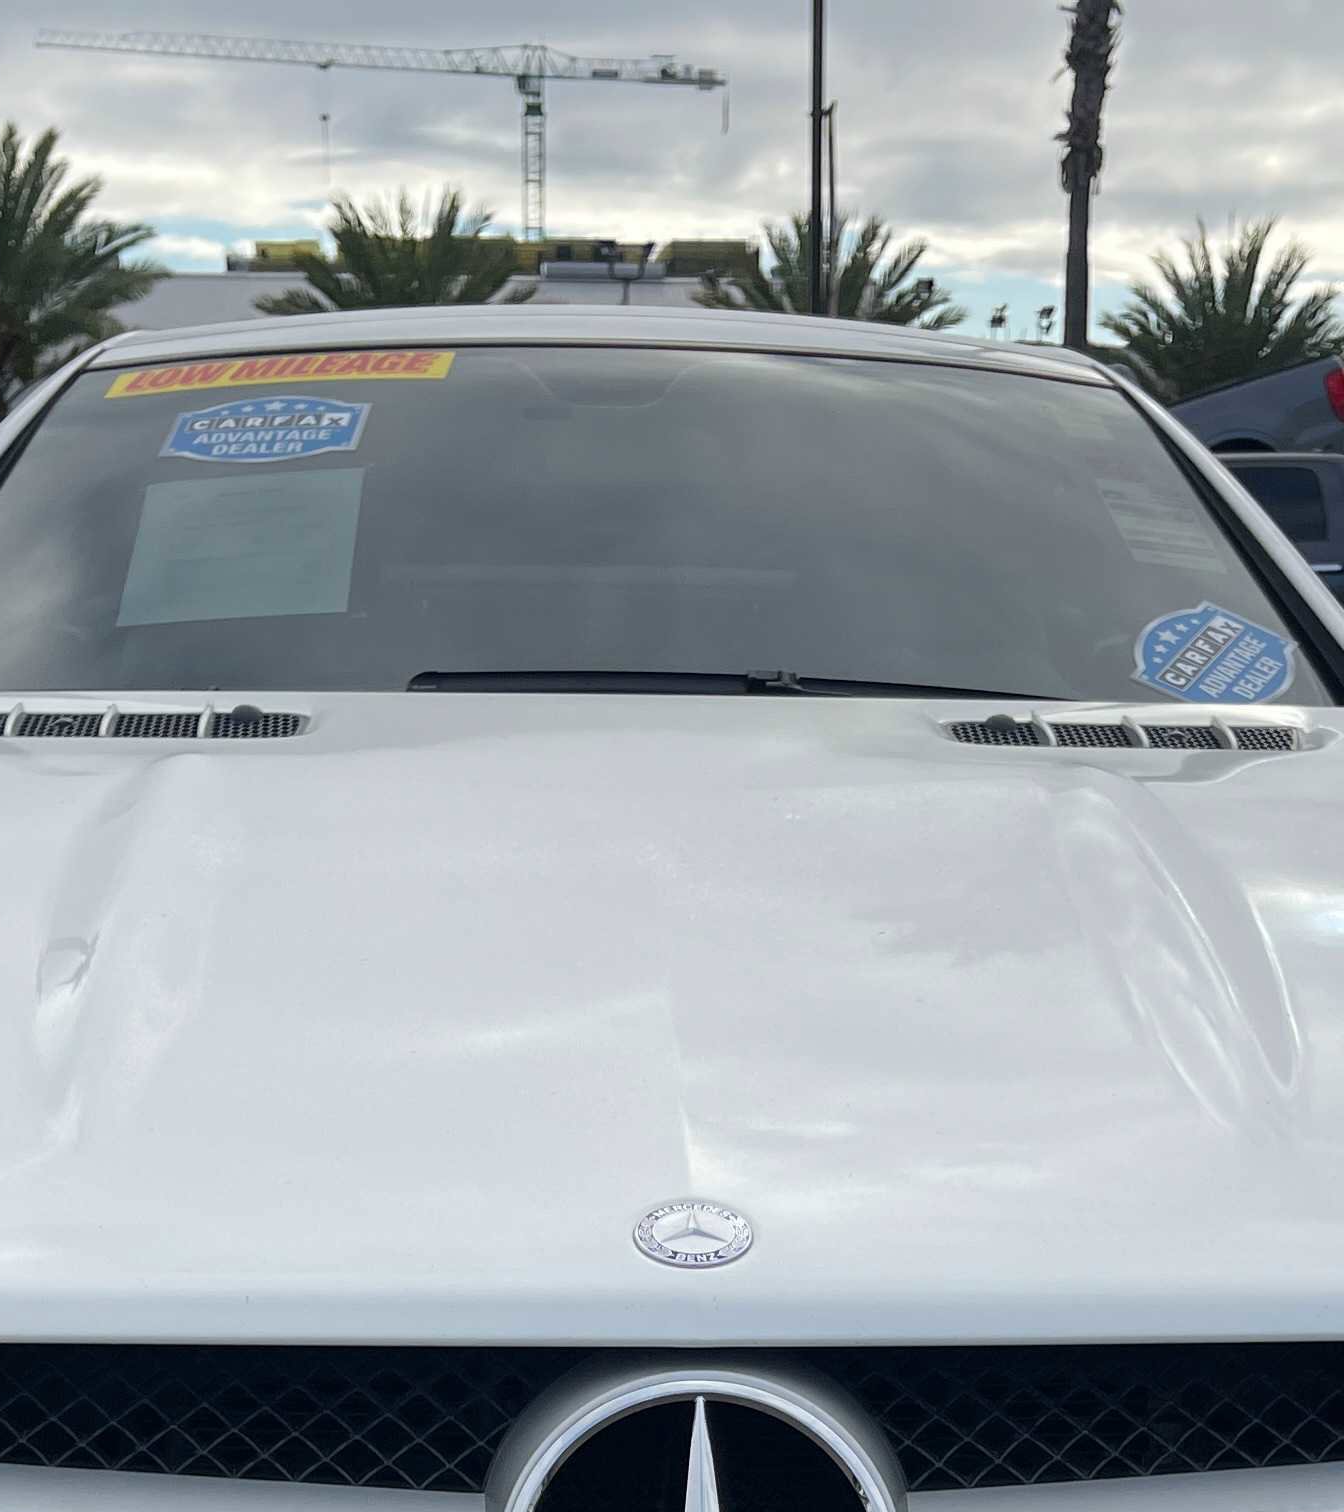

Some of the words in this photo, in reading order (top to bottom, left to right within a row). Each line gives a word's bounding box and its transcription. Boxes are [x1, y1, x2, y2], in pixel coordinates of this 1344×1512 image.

[125, 361, 230, 392] LOW
[229, 351, 441, 381] MILEAGE
[190, 414, 346, 431] CARFAX
[193, 429, 334, 445] ADVANTAGE
[211, 441, 304, 456] DEALER
[1161, 618, 1245, 687] CARFAX
[1199, 635, 1267, 698] ADVANTAGE
[1231, 656, 1284, 700] DEALER
